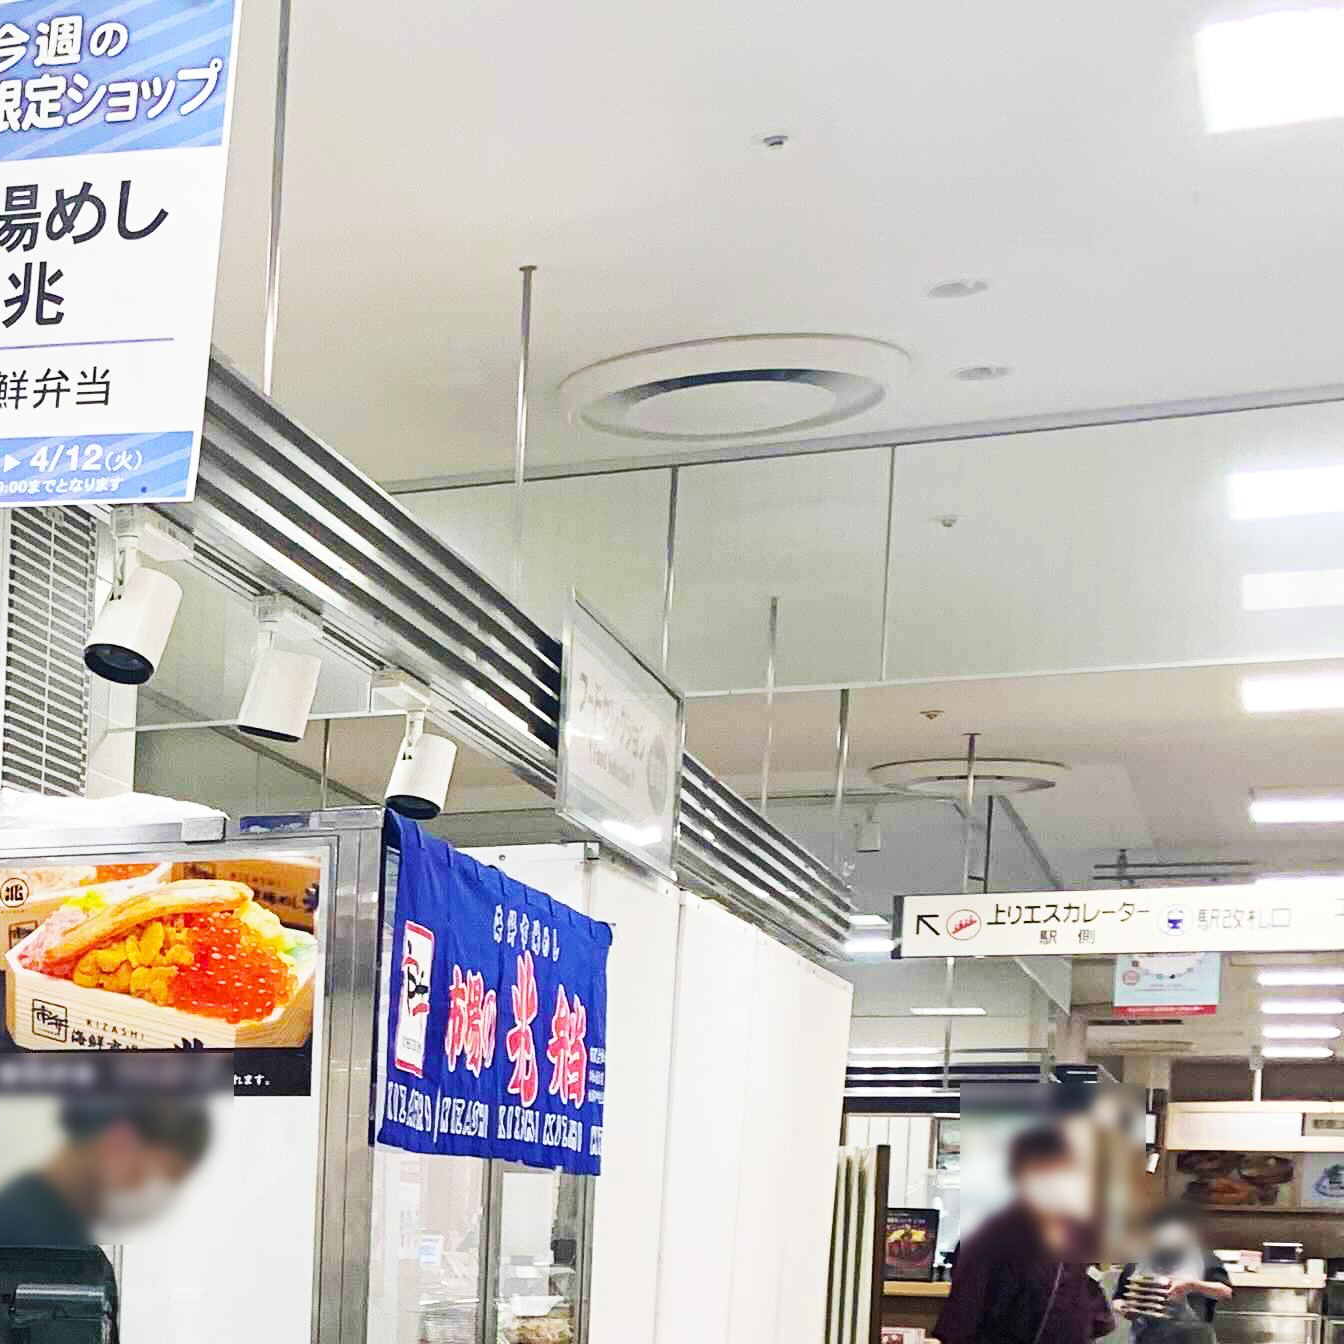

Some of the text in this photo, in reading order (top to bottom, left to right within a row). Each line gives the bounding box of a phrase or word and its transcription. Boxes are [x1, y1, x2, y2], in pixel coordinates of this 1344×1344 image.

[2, 261, 65, 328] 兆
[986, 902, 1150, 926] 上りエスカレーター
[1197, 907, 1292, 930] 駅改札口
